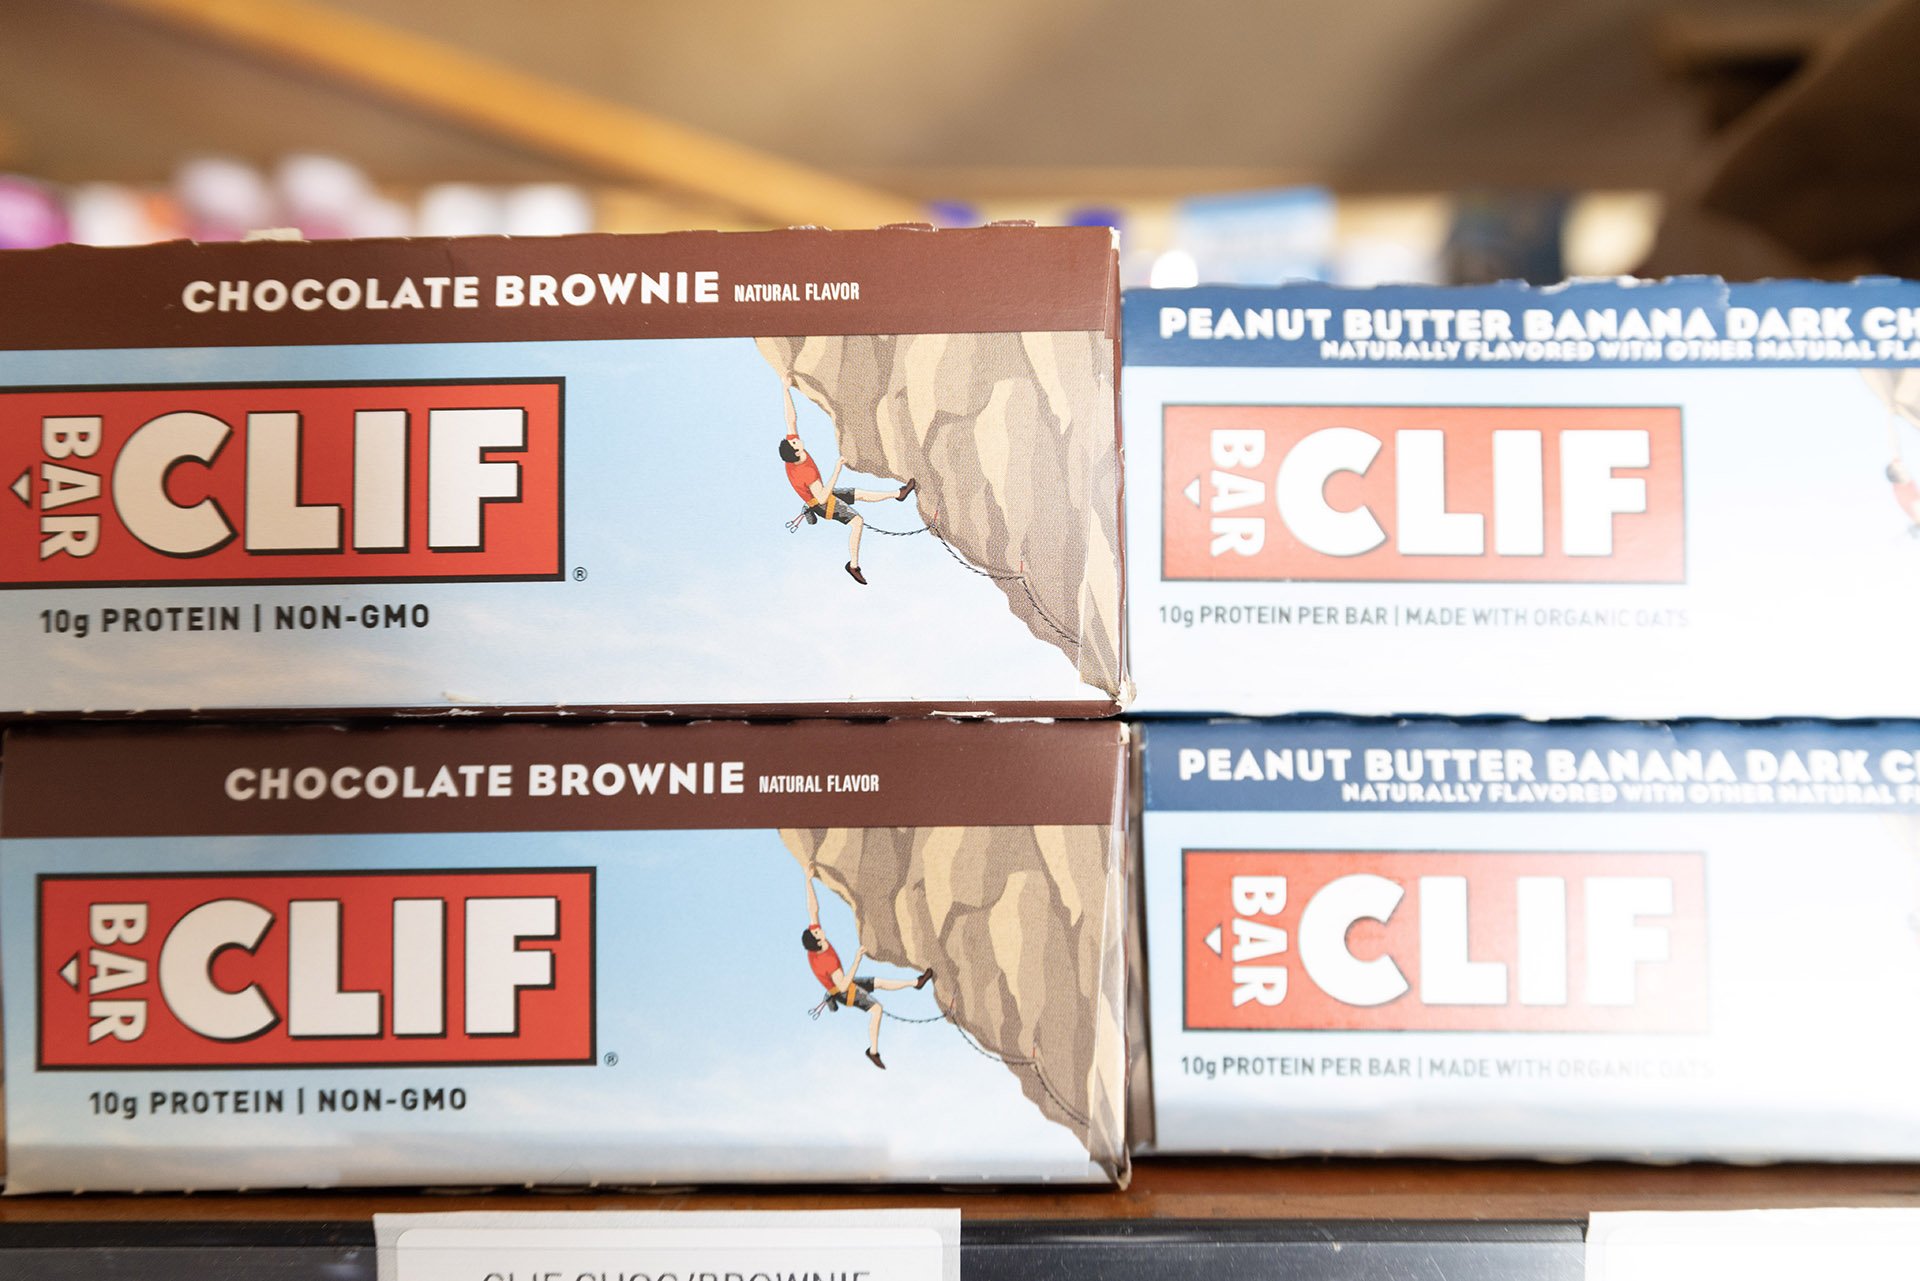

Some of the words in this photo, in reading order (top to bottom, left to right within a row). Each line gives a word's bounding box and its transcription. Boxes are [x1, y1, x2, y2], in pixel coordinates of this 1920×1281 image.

[182, 275, 480, 313] CHOCOLATE
[495, 270, 719, 307] BROWNIE
[734, 283, 801, 304] NATURAL
[805, 281, 860, 302] FLAVOR
[1159, 306, 1332, 340] PEANUT
[1343, 307, 1513, 341] BUTTER
[1523, 307, 1717, 341] BANANA
[1726, 306, 1855, 341] DARK
[1320, 340, 1461, 361] NATURALLY
[1464, 340, 1595, 362] FLAVORED
[1599, 340, 1662, 361] WITH
[1665, 340, 1753, 361] OTHER
[1756, 339, 1876, 361] NATURAL
[40, 415, 103, 560] BAR
[112, 407, 527, 557] CLIF
[1210, 428, 1266, 558] BAR
[1275, 426, 1651, 558] CLIF
[40, 608, 89, 639] 10g
[102, 605, 240, 633] PROTEIN
[274, 603, 430, 631] NON-GMO
[1159, 605, 1195, 629] 10g
[1200, 605, 1292, 625] PROTEIN
[1298, 606, 1339, 626] PER
[1345, 606, 1388, 626] BAR
[1406, 606, 1466, 627] MADE
[1472, 607, 1529, 627] WITH
[1533, 607, 1630, 628] ORGANIC
[225, 763, 513, 801] CHOCOLATE
[528, 761, 745, 797] BROWNIE
[758, 775, 823, 794] NATURAL
[827, 773, 880, 793] FLAVOR
[1178, 748, 1352, 782] PEANUT
[1364, 748, 1536, 783] BUTTER
[1546, 748, 1738, 783] BANANA
[1745, 748, 1873, 784] DARK
[1342, 782, 1483, 803] NATURALLY
[1487, 783, 1618, 803] FLAVORED
[1620, 783, 1685, 804] WITH
[1776, 783, 1897, 804] NATURAL
[1231, 875, 1288, 1008] BAR
[1299, 873, 1674, 1008] CLIF
[88, 902, 149, 1045] BAR
[158, 896, 560, 1043] CLIF
[1181, 1055, 1217, 1080] 10g
[1222, 1056, 1315, 1077] PROTEIN
[1321, 1057, 1363, 1077] PER
[1368, 1057, 1412, 1077] BAR
[1429, 1057, 1489, 1078] MADE
[1495, 1057, 1551, 1078] WITH
[1558, 1057, 1652, 1079] ORGANIC
[89, 1090, 138, 1120] 10g
[150, 1089, 284, 1115] PROTEIN
[318, 1087, 467, 1113] NON-GMO
